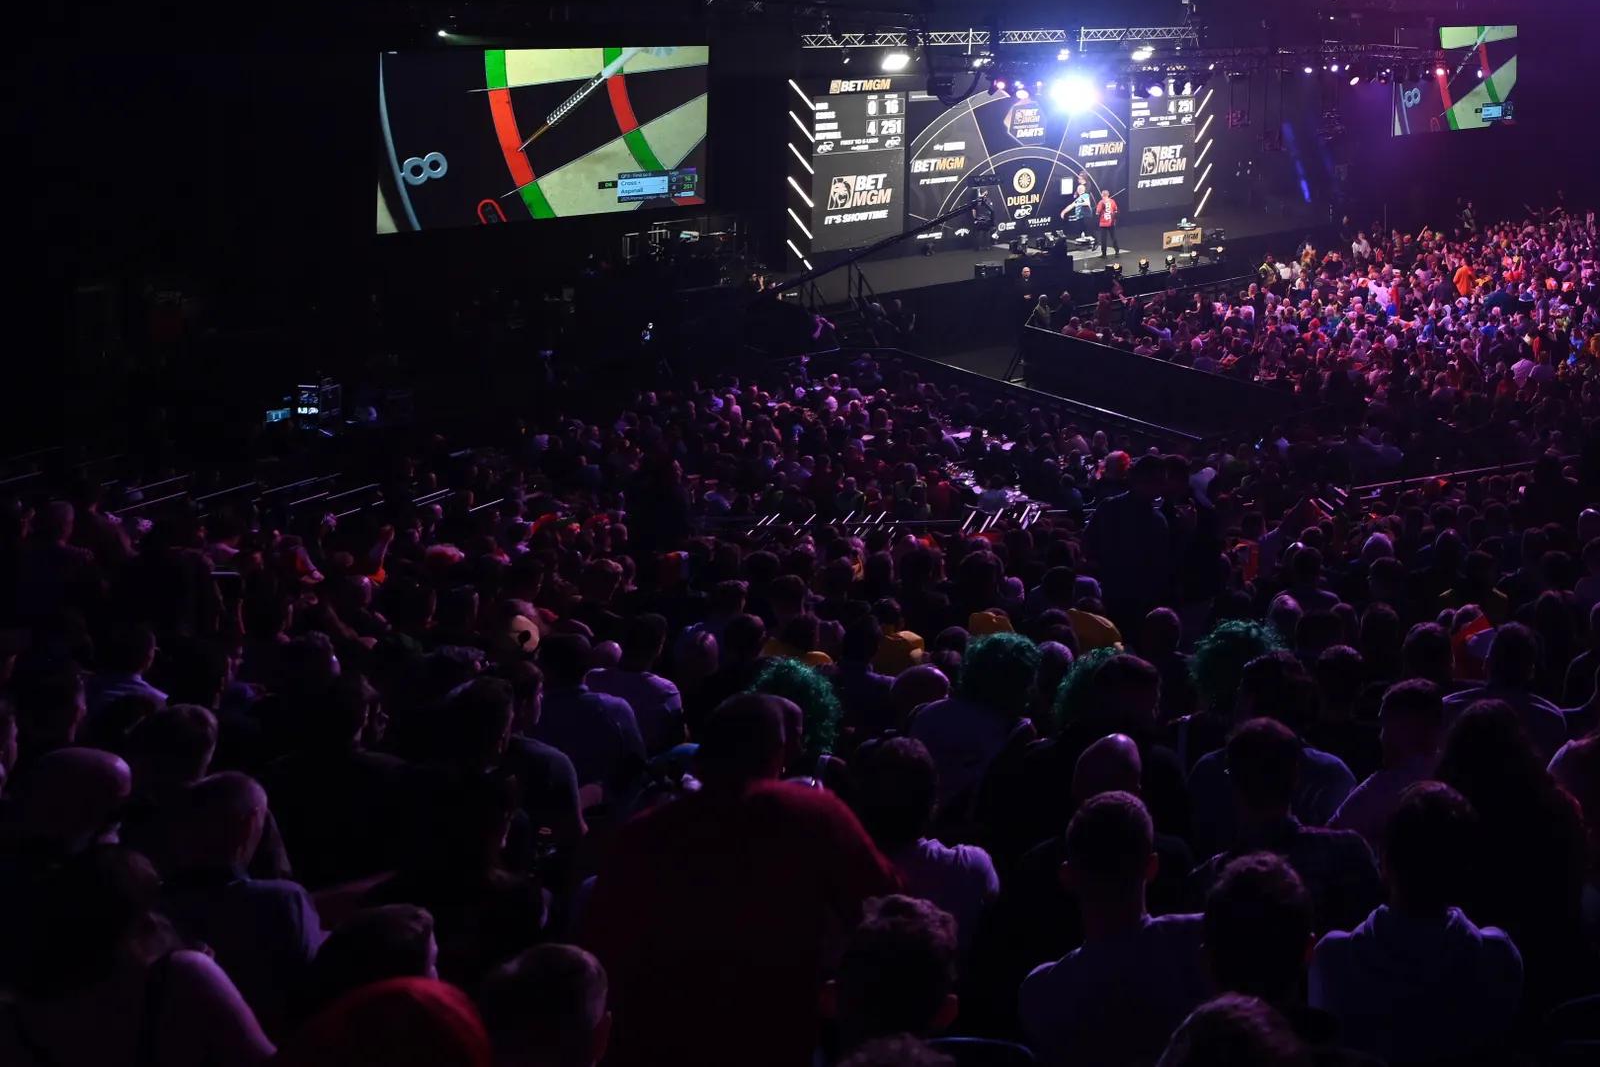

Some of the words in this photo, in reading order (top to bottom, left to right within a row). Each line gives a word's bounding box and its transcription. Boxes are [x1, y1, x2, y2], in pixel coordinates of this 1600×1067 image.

[840, 78, 891, 93] BETMGM
[880, 119, 902, 135] 251
[1081, 142, 1124, 156] BETMGM
[1160, 144, 1183, 160] BET
[402, 151, 448, 186] 8
[913, 156, 966, 173] BETMGM
[1159, 158, 1187, 173] MGM
[855, 173, 888, 191] BET
[852, 188, 893, 207] MGM
[1007, 193, 1040, 206] DUBLIN
